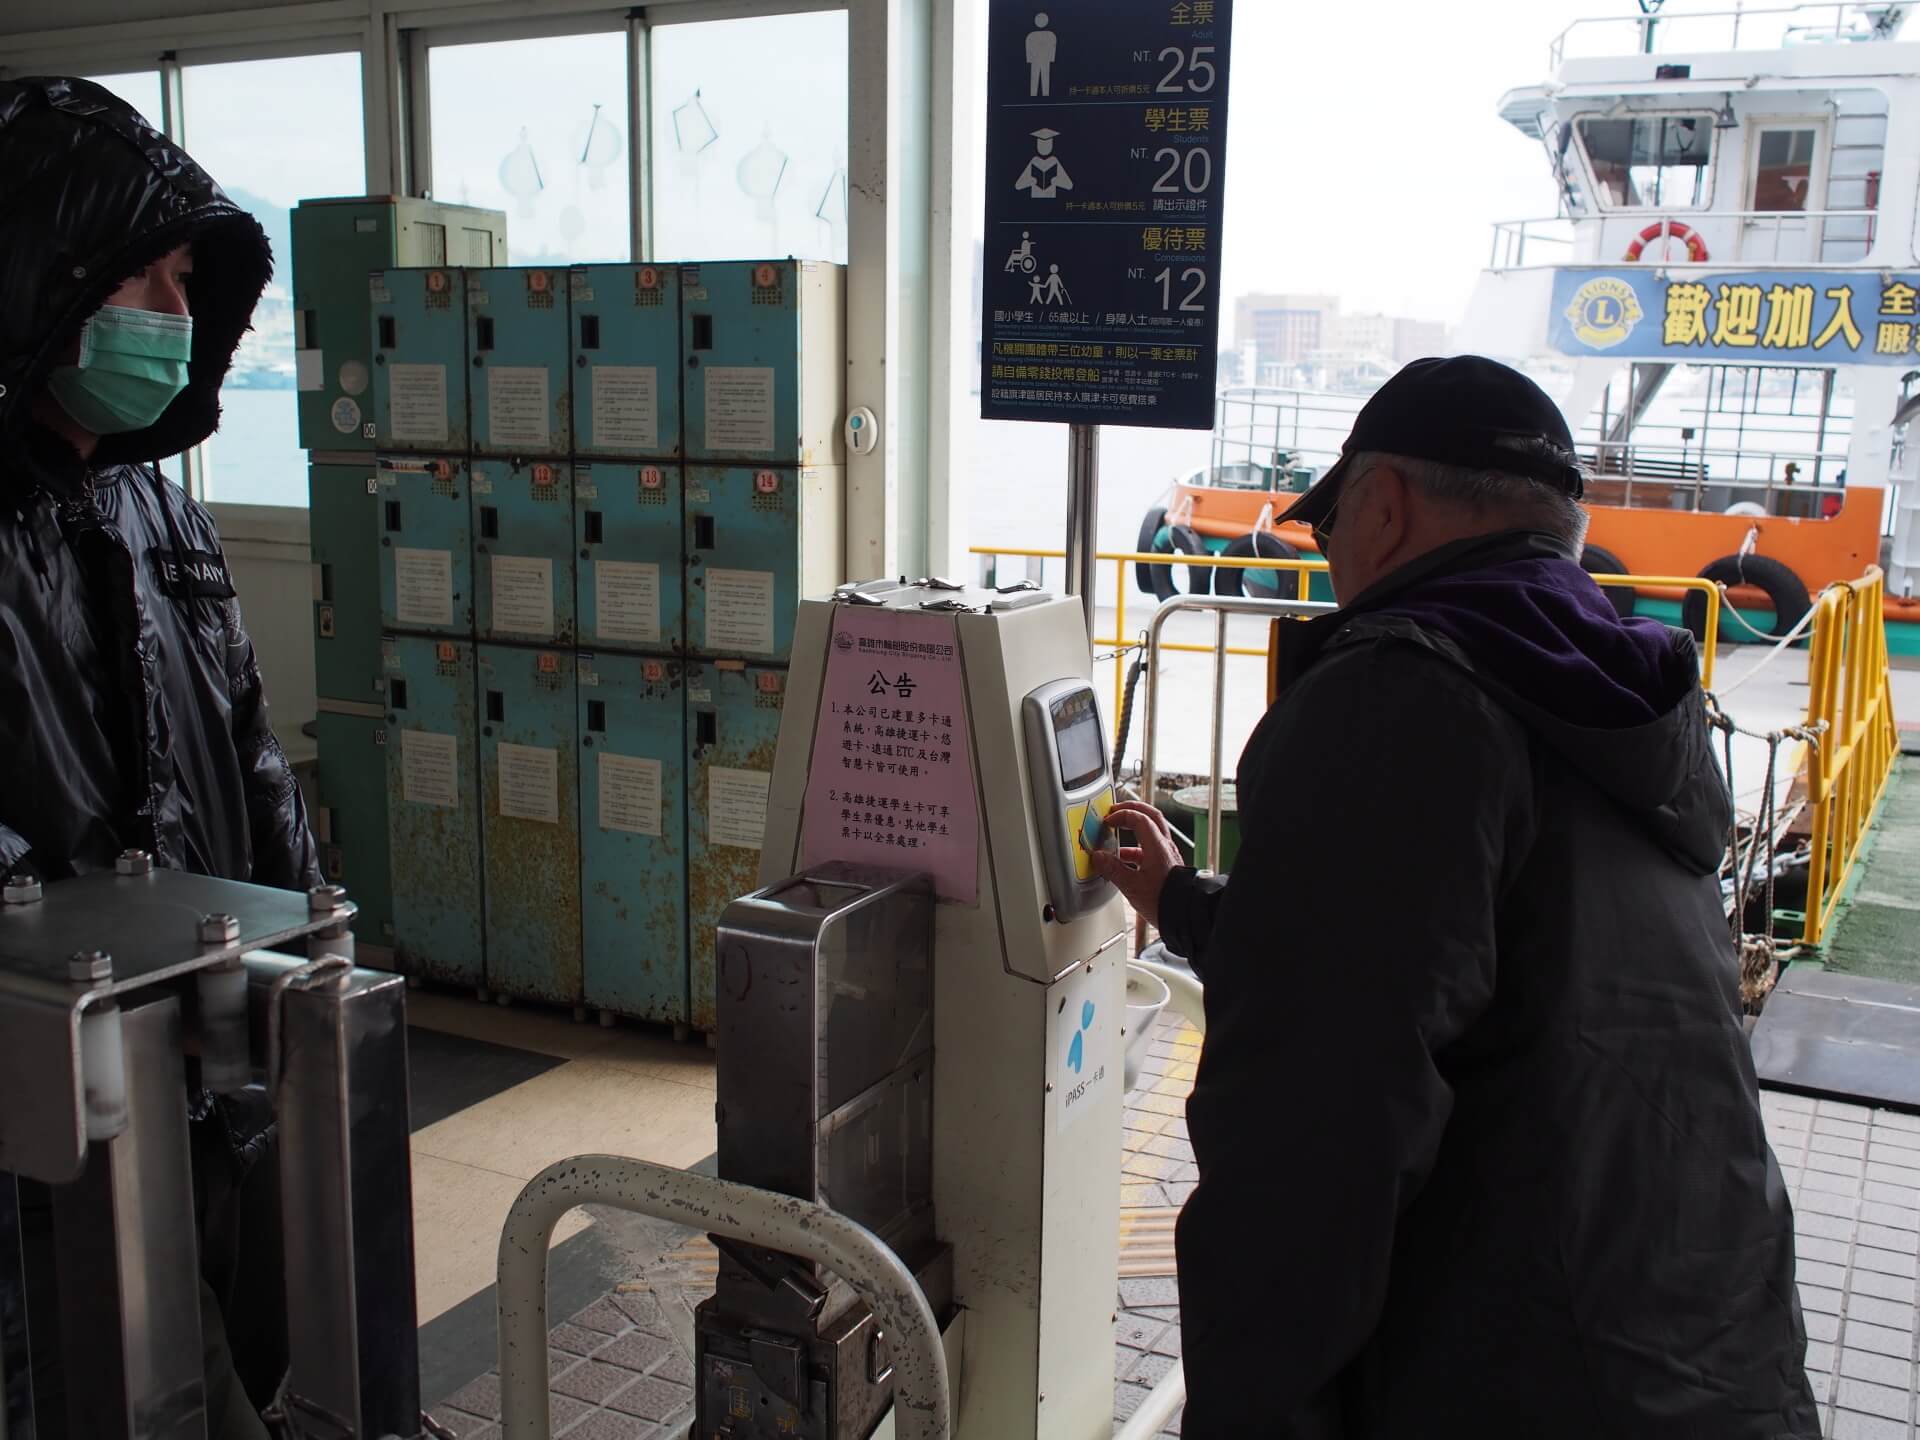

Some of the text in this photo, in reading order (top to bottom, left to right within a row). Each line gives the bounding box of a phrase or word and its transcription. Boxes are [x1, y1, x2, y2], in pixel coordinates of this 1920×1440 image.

[1170, 1, 1214, 25] 全票
[1156, 47, 1216, 93] 25
[1145, 108, 1209, 132] 學生票
[1174, 134, 1209, 144] Students
[1152, 147, 1212, 193] 20
[1153, 199, 1207, 211] 請出示證件
[1142, 227, 1206, 251] 優待票
[1154, 253, 1206, 263] Concessions
[1154, 267, 1207, 312] 12
[1878, 282, 1920, 316] 全
[994, 311, 1033, 322] 國小學生
[1048, 312, 1089, 324] 65歲以上
[1106, 313, 1148, 326] 身障人士
[1595, 300, 1614, 325] L
[1663, 282, 1863, 351] 歡迎加入
[1874, 321, 1920, 355] 服
[992, 365, 1100, 381] 請自備零錢投幣登船
[538, 469, 549, 482] 12
[645, 470, 657, 484] 13
[761, 474, 774, 488] 14
[647, 664, 659, 676] 23
[867, 670, 917, 698] 公告
[831, 701, 952, 728] 1. 本公司已建置多卡通
[829, 790, 950, 818] 2. 高雄捷運學生卡可享
[1065, 1081, 1085, 1109] iPASS
